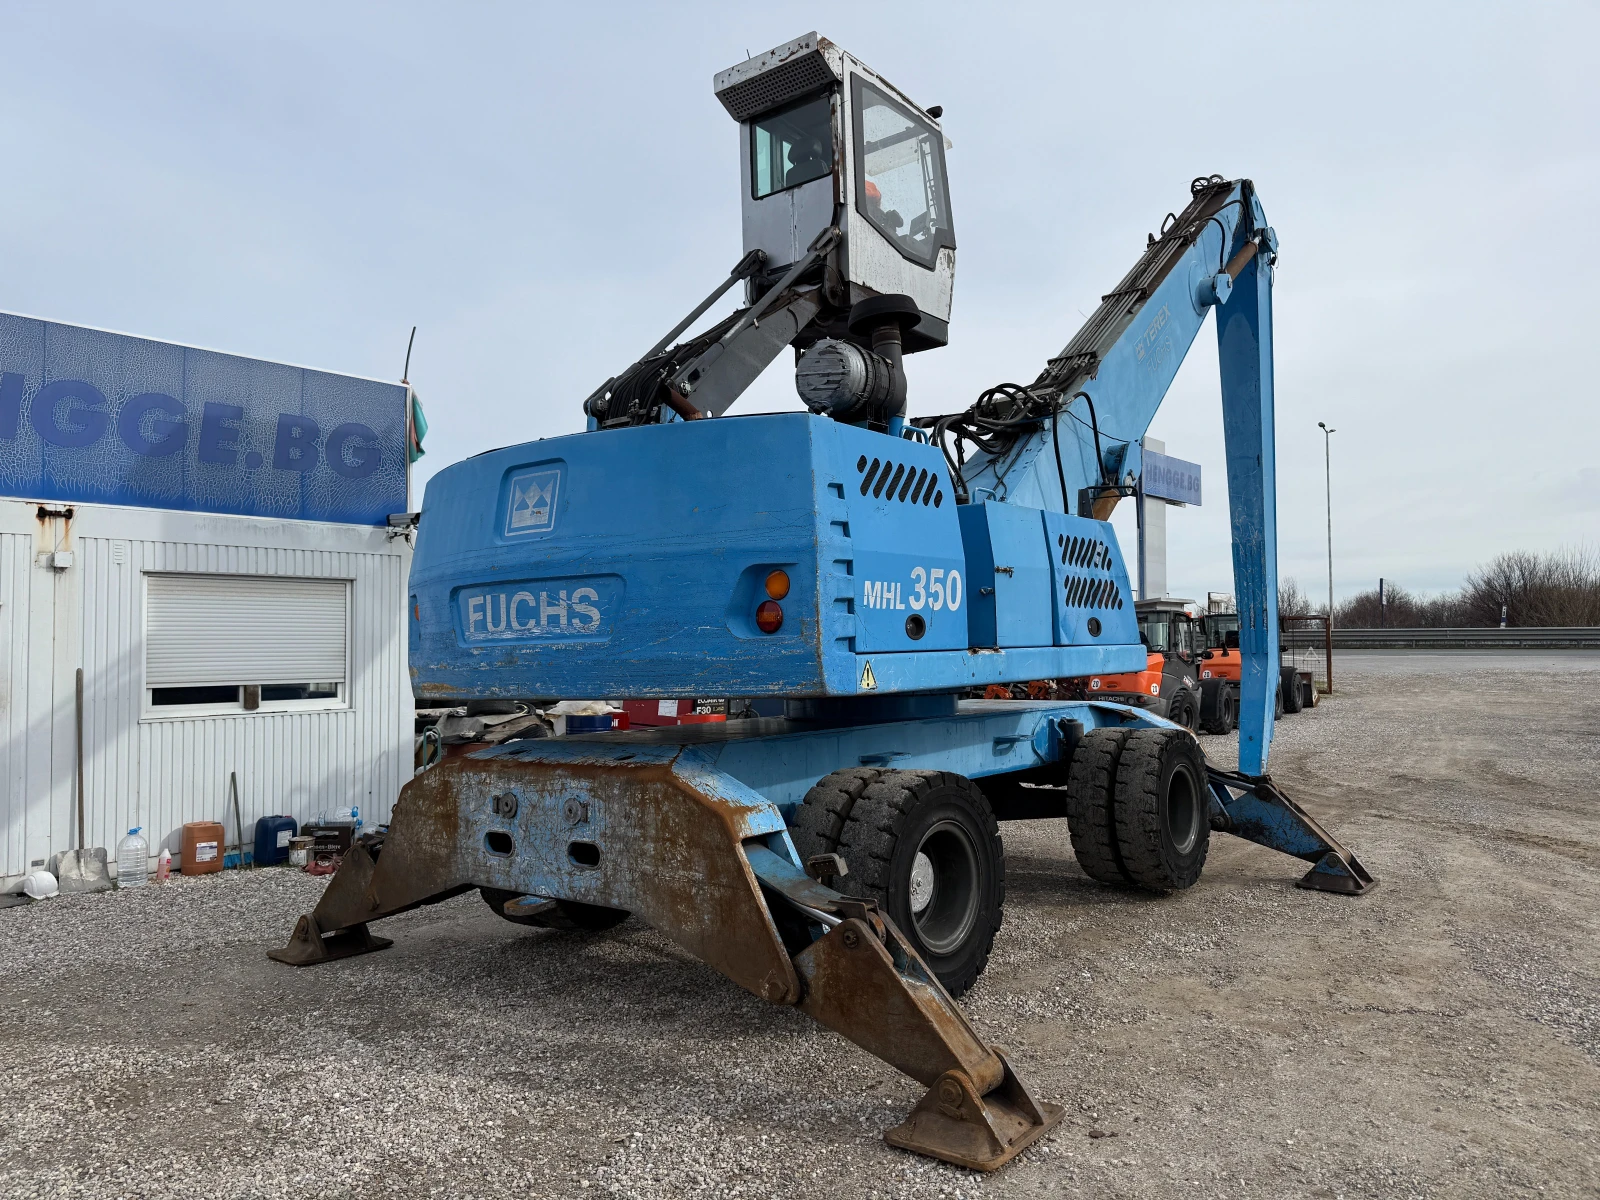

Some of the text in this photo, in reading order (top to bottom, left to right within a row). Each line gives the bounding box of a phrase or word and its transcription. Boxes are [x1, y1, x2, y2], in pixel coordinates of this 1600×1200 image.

[1143, 302, 1171, 347] TEREX
[1147, 335, 1171, 371] FUCHS
[1145, 462, 1200, 492] HENGGE.BG
[863, 566, 962, 611] MHL 350
[468, 587, 601, 634] FUCHS
[1092, 680, 1099, 688] 20
[1152, 685, 1158, 693] 20
